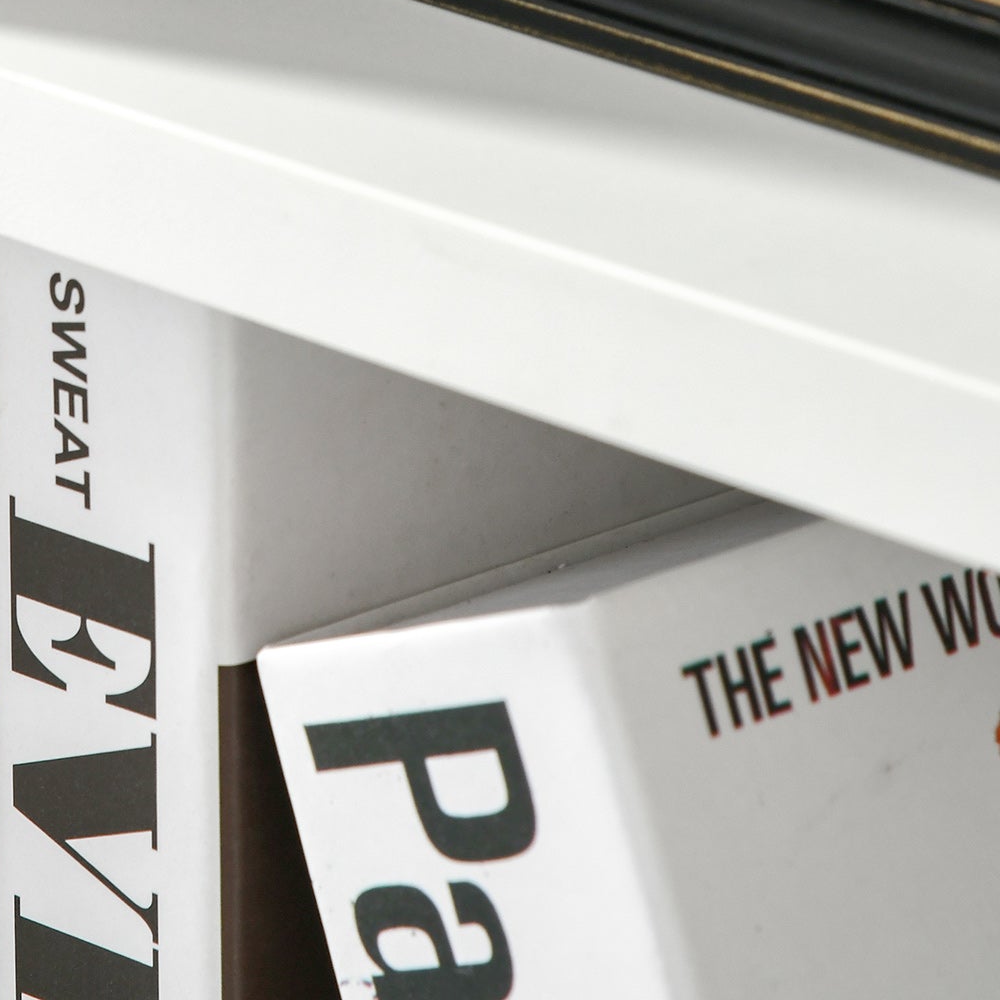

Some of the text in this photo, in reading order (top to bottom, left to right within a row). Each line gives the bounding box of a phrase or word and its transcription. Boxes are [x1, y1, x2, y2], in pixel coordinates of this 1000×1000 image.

[50, 272, 91, 511] SWEAT
[682, 633, 792, 738] THE
[793, 590, 915, 703] NEW
